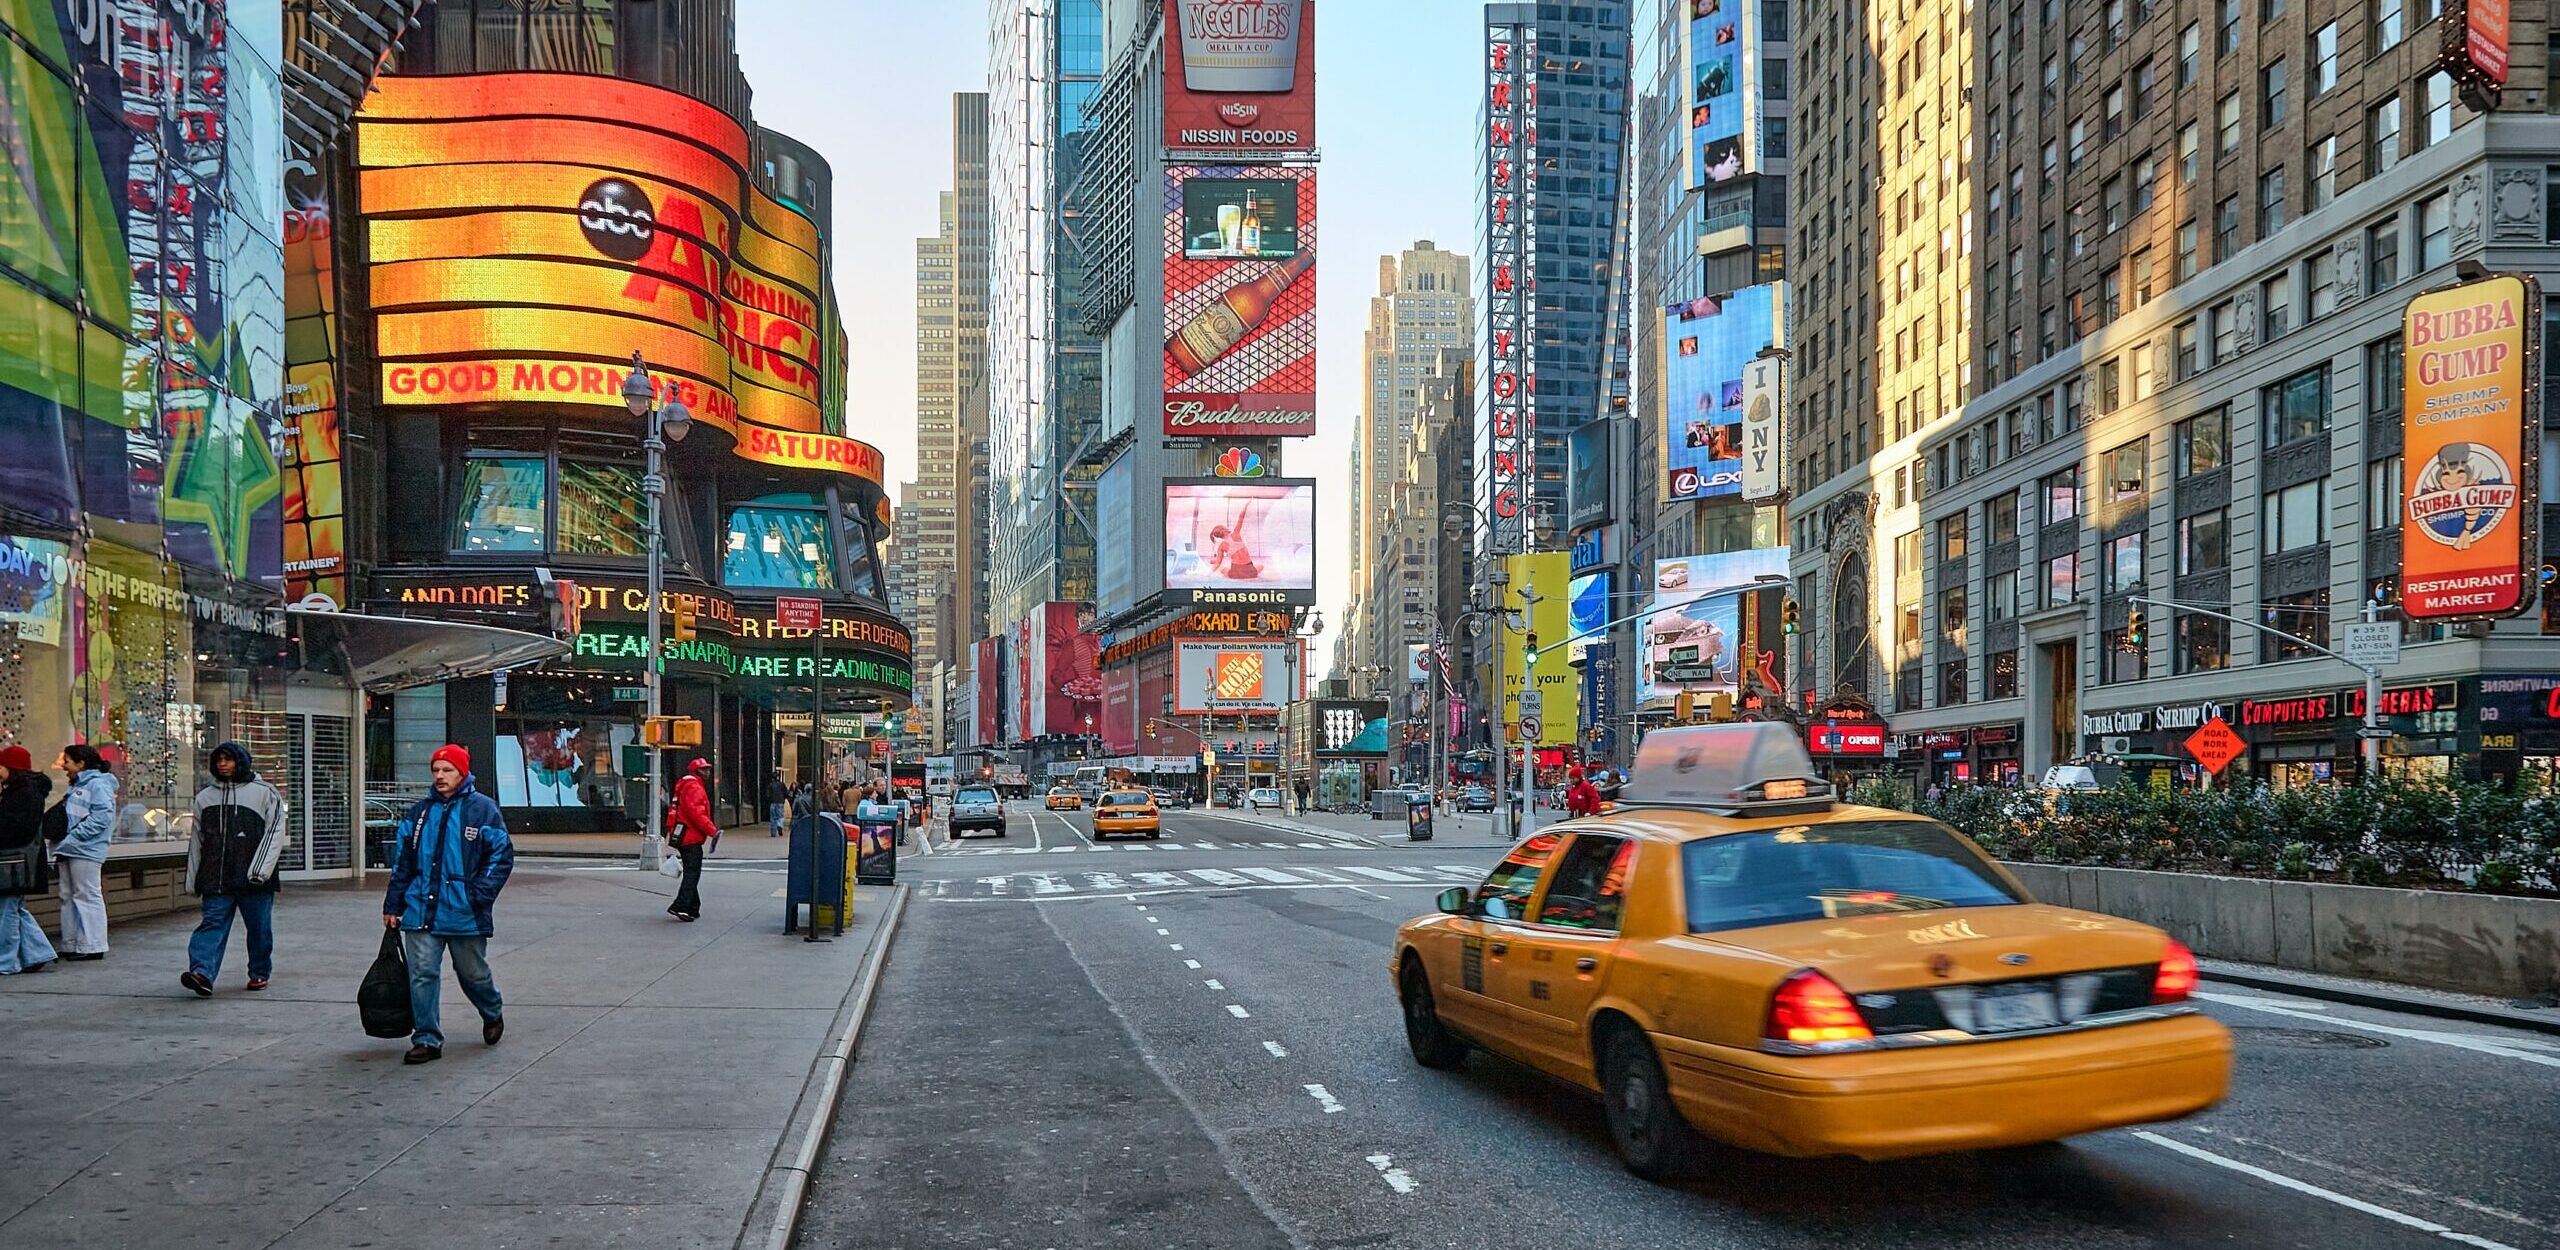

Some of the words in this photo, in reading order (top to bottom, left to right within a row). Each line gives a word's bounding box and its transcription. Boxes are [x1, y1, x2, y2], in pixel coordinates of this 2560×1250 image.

[1187, 2, 1291, 40] NOODLES
[1222, 103, 1258, 117] NISSIN
[1181, 129, 1236, 144] NISSIN
[1242, 129, 1297, 144] FOODS
[1492, 44, 1511, 223] ERNST
[580, 197, 652, 240] abc
[1494, 264, 1512, 293] &
[2411, 299, 2517, 348] BUBBA
[2418, 343, 2509, 386] GUMP
[286, 384, 308, 394] Boys
[389, 364, 497, 396] GOOD
[512, 364, 697, 409] MORNNG
[2425, 387, 2500, 409] SHRIMP
[285, 403, 320, 415] Rejects
[1165, 401, 1313, 427] Budweiser
[2415, 399, 2511, 425] COMPANY
[1494, 330, 1516, 517] YOUNG
[1700, 470, 1743, 488] LEX
[2412, 492, 2462, 517] BUBBA
[2466, 487, 2513, 506] GUMP
[2427, 511, 2465, 524] SHRIMP
[2480, 508, 2495, 516] CO
[2407, 573, 2516, 594] RESTAURANT
[95, 567, 126, 598] THE
[130, 578, 190, 614] PERFECT
[194, 595, 216, 622] TOY
[401, 587, 455, 605] AND
[462, 585, 529, 606] DOES
[578, 586, 616, 610] OT
[1193, 590, 1286, 602] Panasonic
[2424, 592, 2496, 610] MARKET
[784, 609, 815, 617] ANYTIME
[791, 601, 819, 610] STANDING
[1247, 613, 1283, 633] ERN
[577, 634, 650, 658] REAK
[2351, 642, 2393, 650] SAT-SUN
[2354, 634, 2390, 642] CLOSED
[1573, 645, 1587, 657] CHAS
[740, 657, 789, 677] ARE
[797, 658, 879, 682] READING
[879, 664, 896, 685] THE
[1217, 652, 1263, 698] HOME
[1221, 657, 1241, 677] THE
[1668, 670, 1682, 678] ONE
[1233, 670, 1263, 698] DEPOT
[1505, 674, 1518, 686] TV
[1537, 675, 1567, 687] your
[621, 689, 630, 698] 44
[1521, 702, 1541, 710] TURNS
[1827, 709, 1846, 719] Hard
[1846, 710, 1864, 719] Rock
[2243, 697, 2326, 725] COMPUTERS
[2353, 688, 2434, 717] CMERAS
[829, 719, 860, 727] RBUCKS
[2083, 713, 2113, 736] BUBBA
[2114, 711, 2144, 733] GUMP
[2156, 704, 2199, 731] SHRIMP
[828, 726, 853, 734] OFFEE
[2203, 729, 2229, 738] ROAD
[1848, 735, 1880, 745] OPEN!
[2203, 739, 2228, 748] WORK
[2201, 751, 2227, 759] AHEAD
